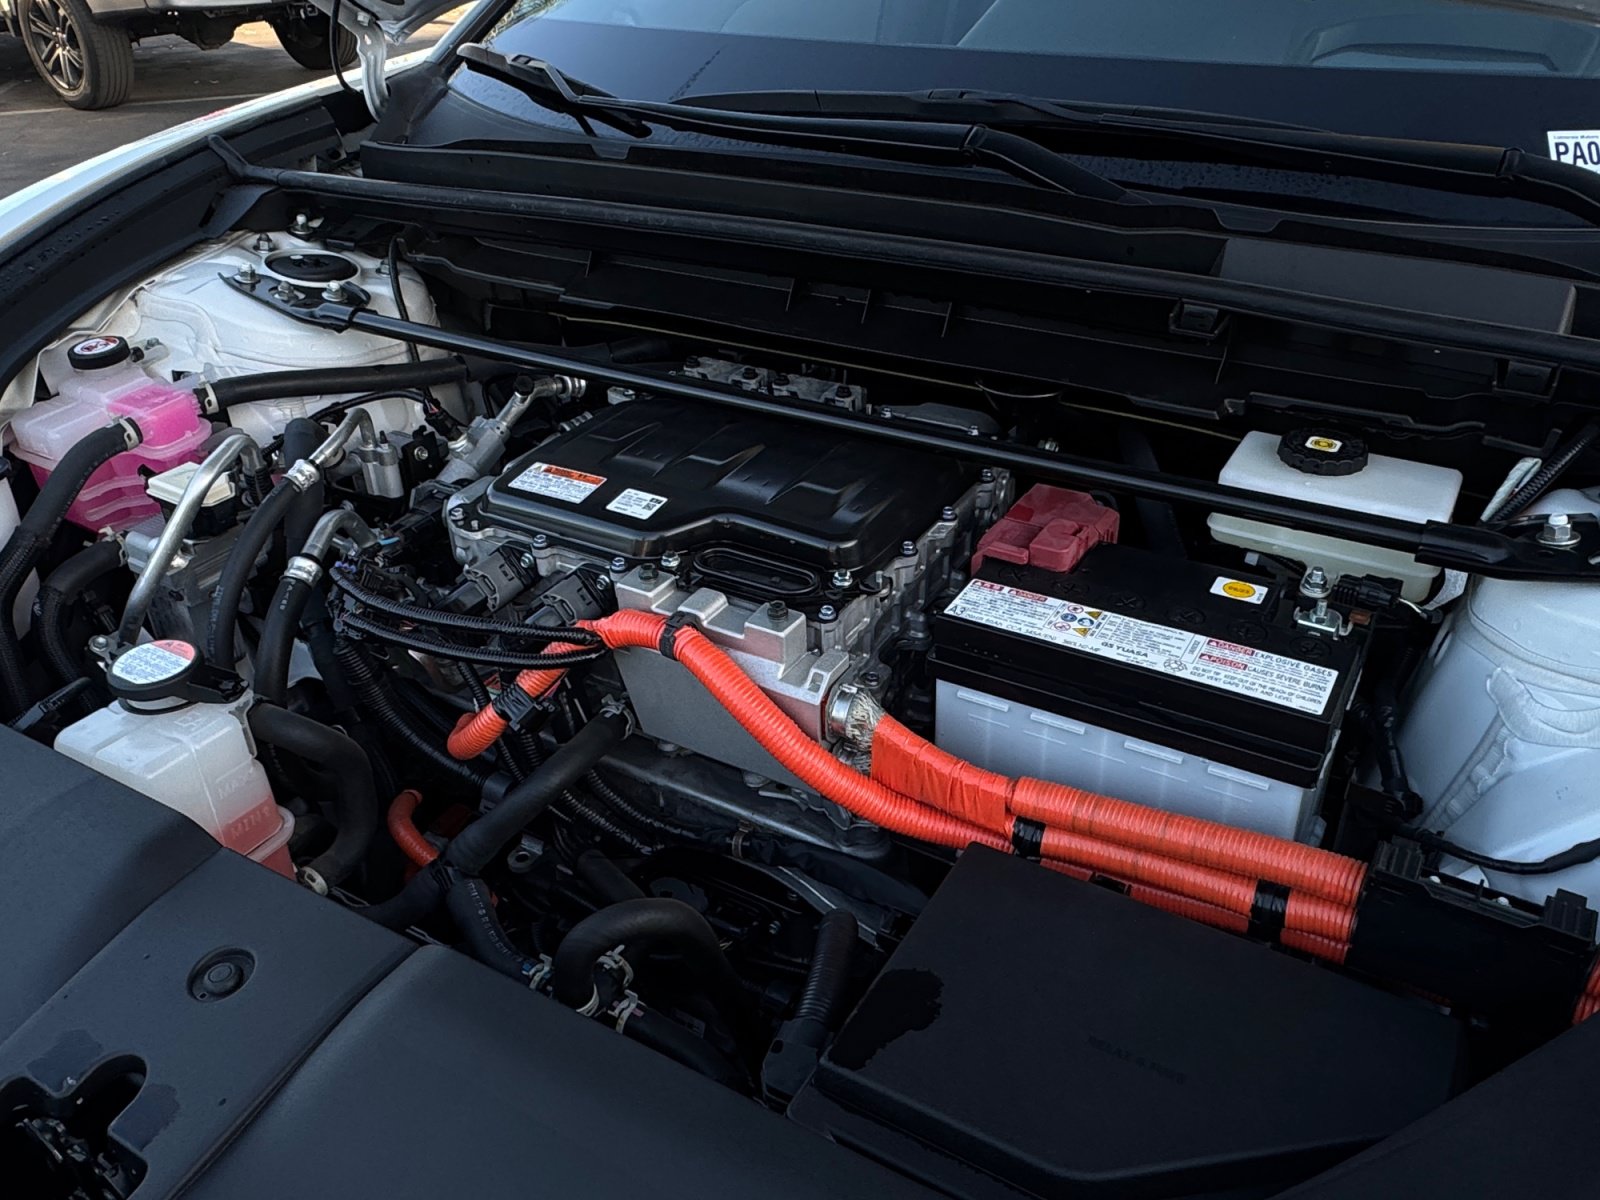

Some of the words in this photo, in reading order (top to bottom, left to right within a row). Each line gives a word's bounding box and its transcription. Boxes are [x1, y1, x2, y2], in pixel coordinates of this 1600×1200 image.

[1115, 645, 1149, 658] YUASA
[1255, 651, 1301, 668] EXPLOSIVE
[1303, 665, 1333, 677] GASES
[1210, 656, 1245, 670] POISON
[1247, 665, 1274, 678] CAUSES
[1275, 673, 1301, 686] SEVERE
[1303, 681, 1328, 693] BURNS
[1274, 693, 1293, 703] LEVEL
[1295, 693, 1322, 705] CHILDREN
